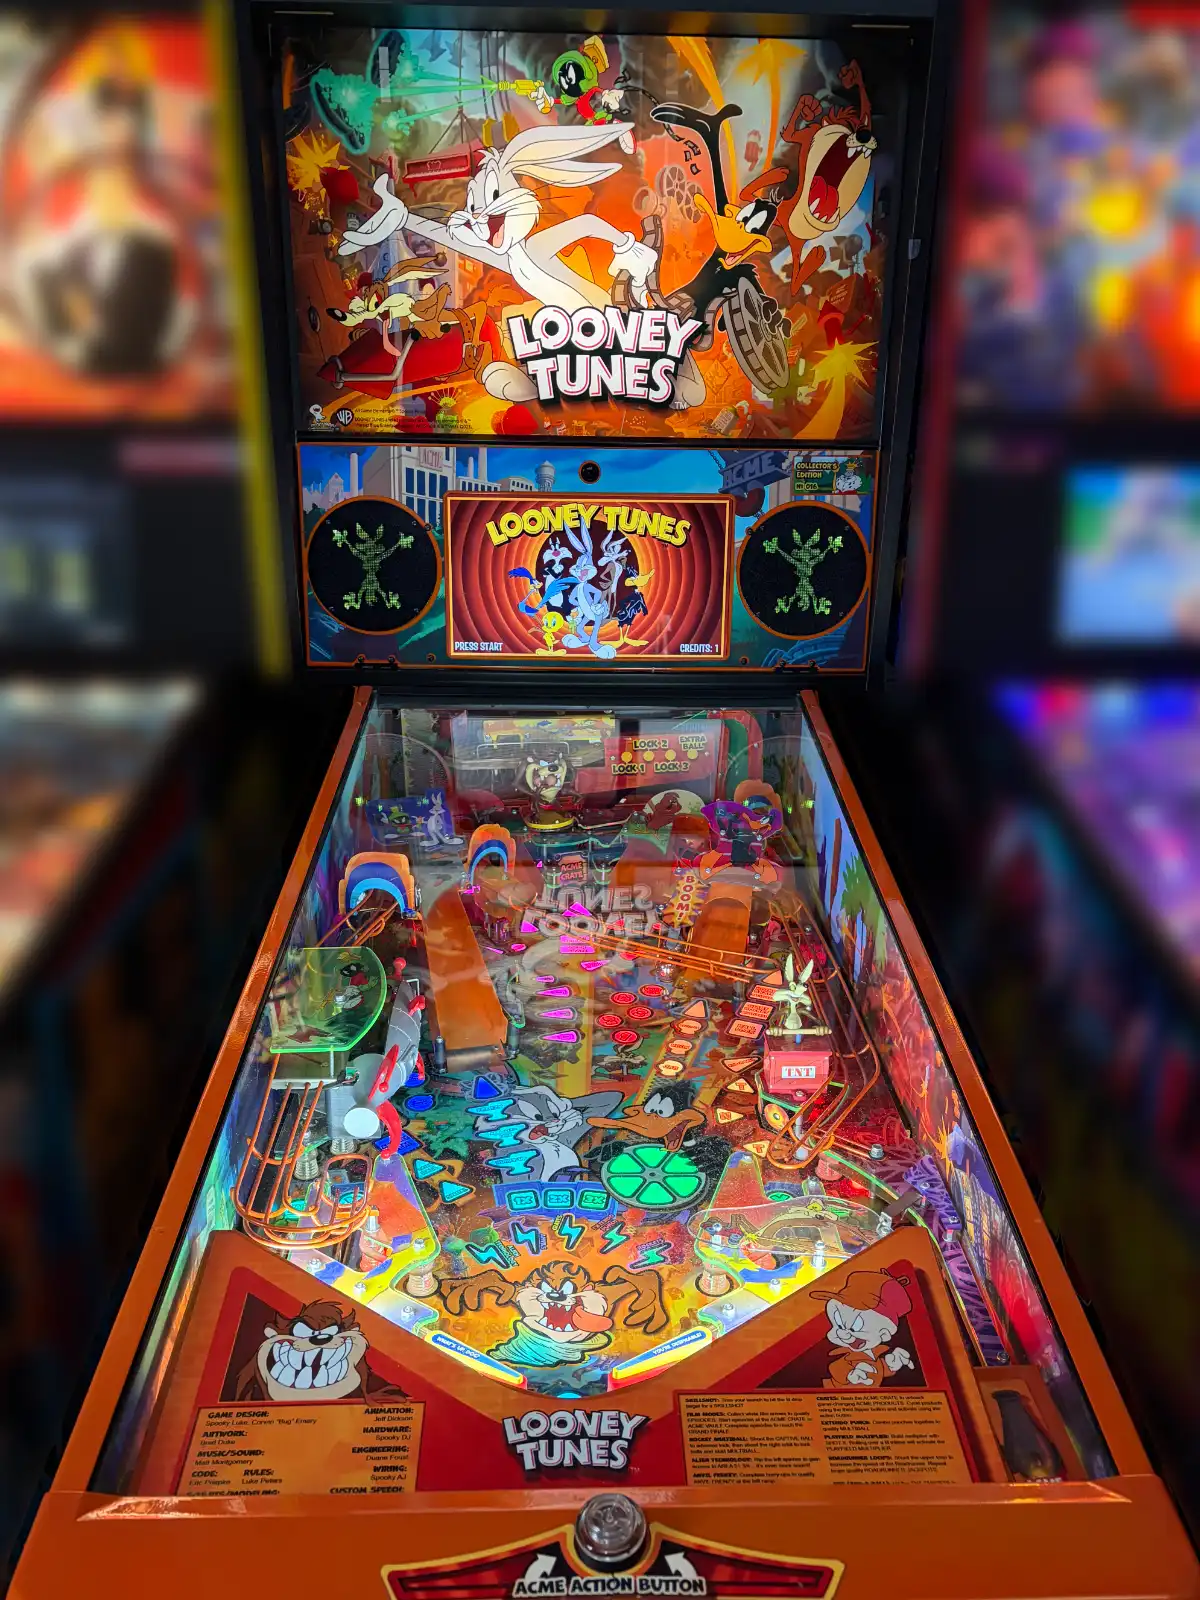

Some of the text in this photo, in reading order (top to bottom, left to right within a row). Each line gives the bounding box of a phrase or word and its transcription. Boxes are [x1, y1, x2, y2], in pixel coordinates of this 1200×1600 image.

[507, 305, 702, 360] LOONEY
[526, 354, 676, 402] TUNES
[724, 452, 775, 488] ACME
[485, 503, 600, 546] LOONEY
[603, 505, 691, 547] TUNES
[454, 641, 503, 652] PRESS START
[680, 643, 719, 653] CREDITS: 1
[680, 735, 706, 743] EXTRA
[633, 740, 668, 749] LOCK 2
[613, 764, 645, 773] LOCK 1
[655, 762, 689, 771] LOCK 3
[560, 860, 583, 871] ACME
[560, 871, 584, 881] CRATE
[676, 875, 695, 920] BOOM!
[785, 1067, 813, 1077] TNT
[736, 1082, 746, 1090] T
[720, 1112, 731, 1120] N
[753, 1144, 765, 1153] T
[513, 1196, 533, 1205] 1X
[548, 1194, 570, 1203] 2X
[584, 1194, 605, 1205] 3X
[208, 1410, 270, 1419] GAME DESIGN:
[363, 1426, 412, 1434] HARDWARE:
[503, 1409, 646, 1444] LOONEY
[202, 1430, 248, 1438] ARTWORK:
[197, 1449, 265, 1458] MUSIC/SOUND:
[352, 1445, 409, 1454] ENGINEERING:
[516, 1438, 629, 1471] TUNES
[192, 1469, 275, 1478] CODE: RULES:
[373, 1465, 407, 1473] WIRING:
[370, 1474, 396, 1482] Spooky
[329, 1486, 367, 1494] CUSTOM
[515, 1578, 703, 1595] ACME ACTION BUTTON
